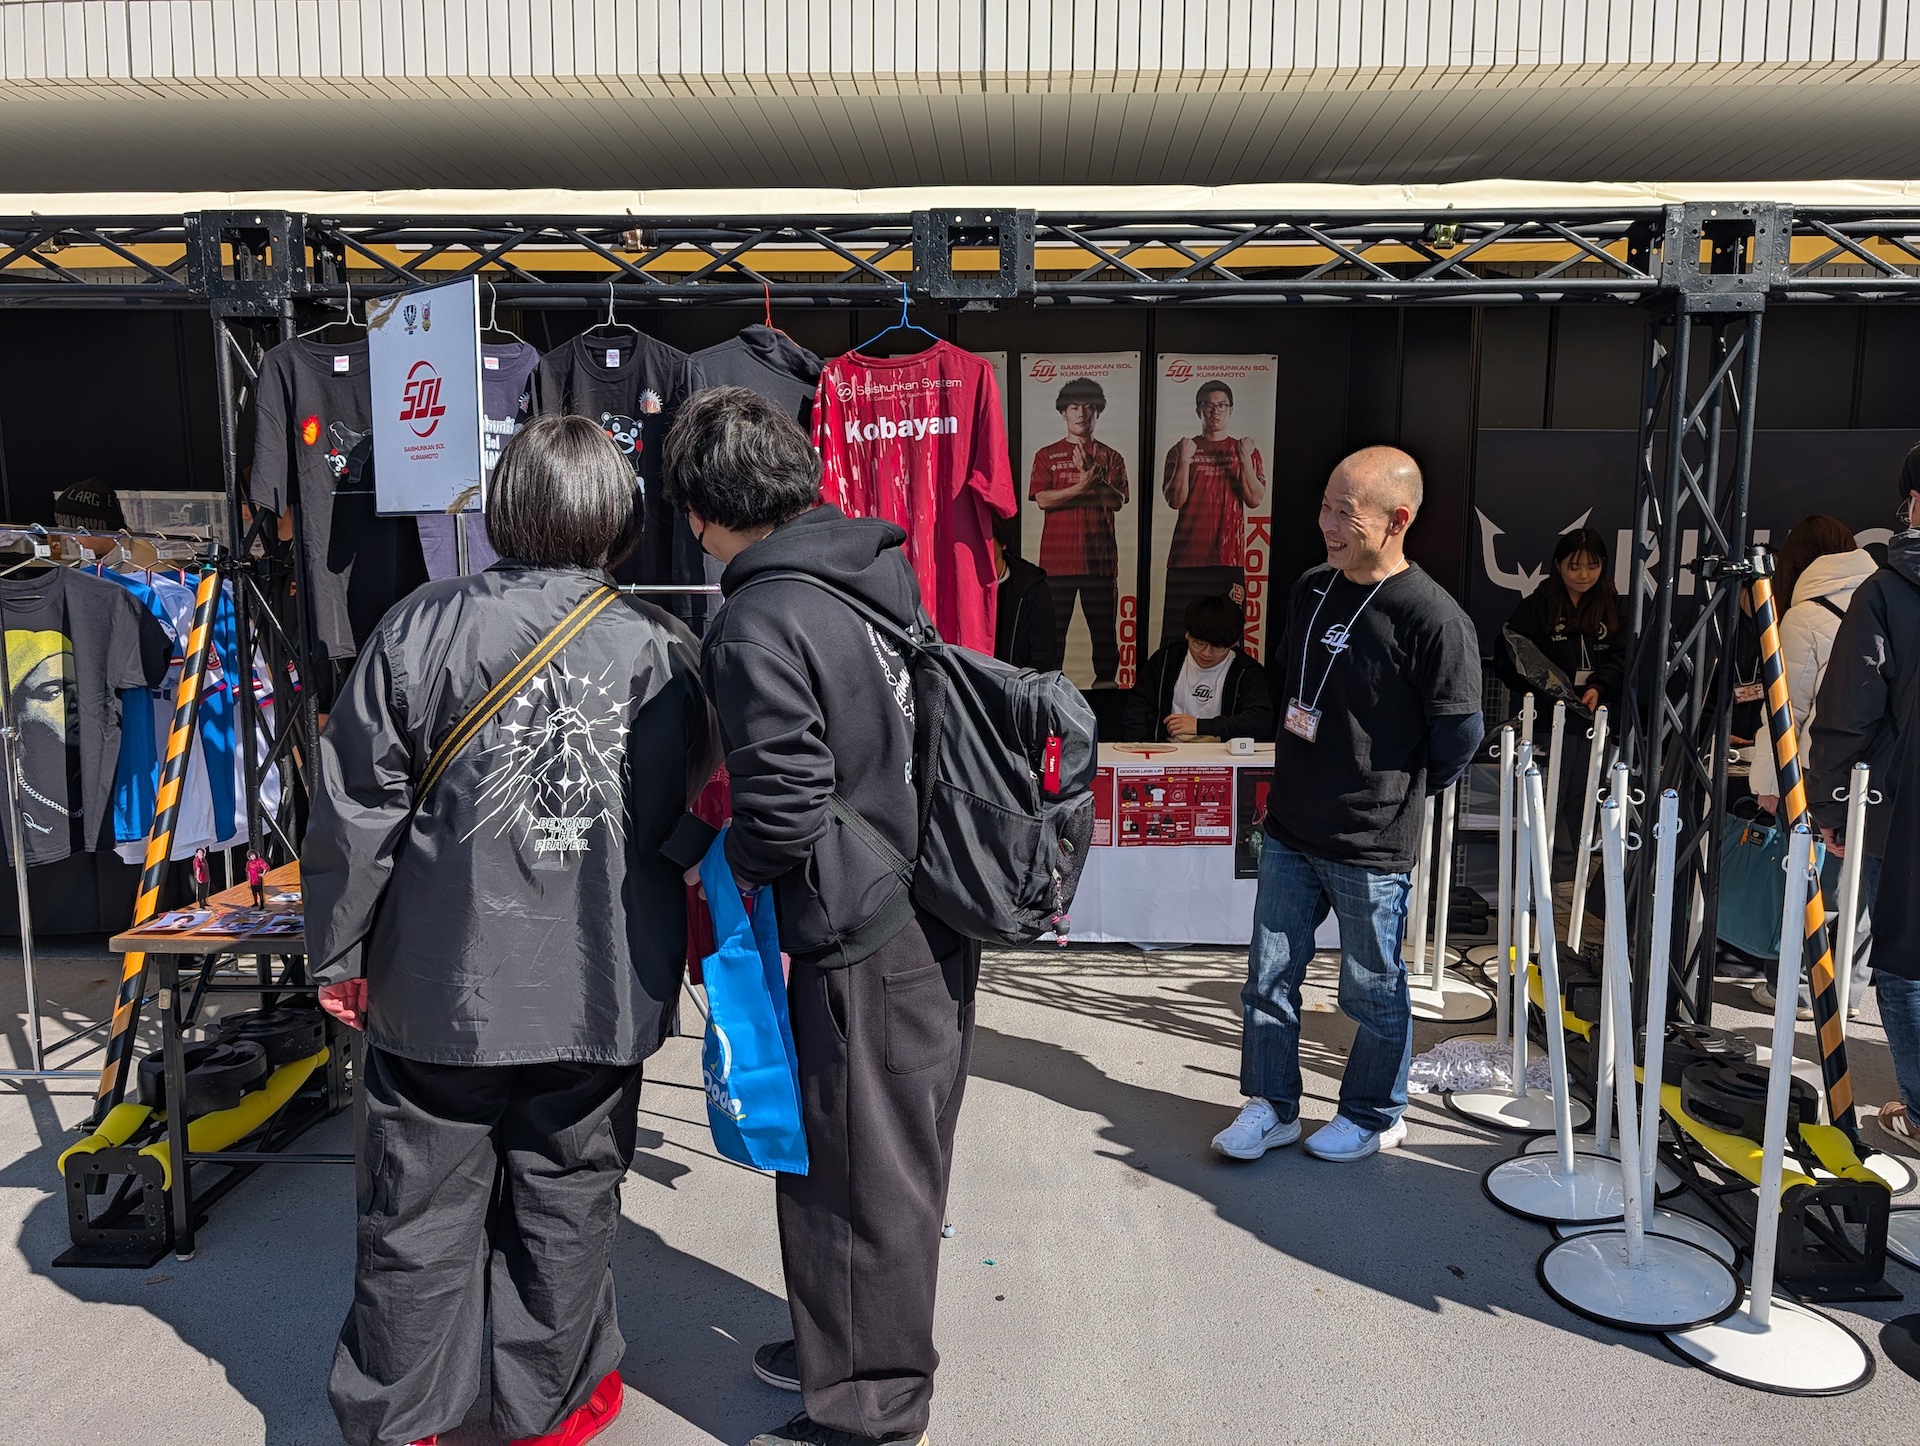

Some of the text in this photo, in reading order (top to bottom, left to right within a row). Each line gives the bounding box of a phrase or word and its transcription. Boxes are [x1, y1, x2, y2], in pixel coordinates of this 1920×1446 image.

[1029, 364, 1058, 378] SOL
[1060, 363, 1115, 371] SAISHUNKAN
[1165, 365, 1194, 378] SOL
[856, 377, 963, 397] Saishunkan System
[399, 377, 446, 422] SOL
[844, 415, 958, 444] Kobayan
[403, 443, 446, 453] SAISHUNKAN SOL
[410, 453, 440, 461] KUMAMOTO
[1320, 629, 1351, 650] SOL
[1192, 688, 1214, 699] SOL
[538, 817, 594, 829] BEYOND
[547, 828, 578, 840] THE
[533, 839, 591, 851] PRAYER
